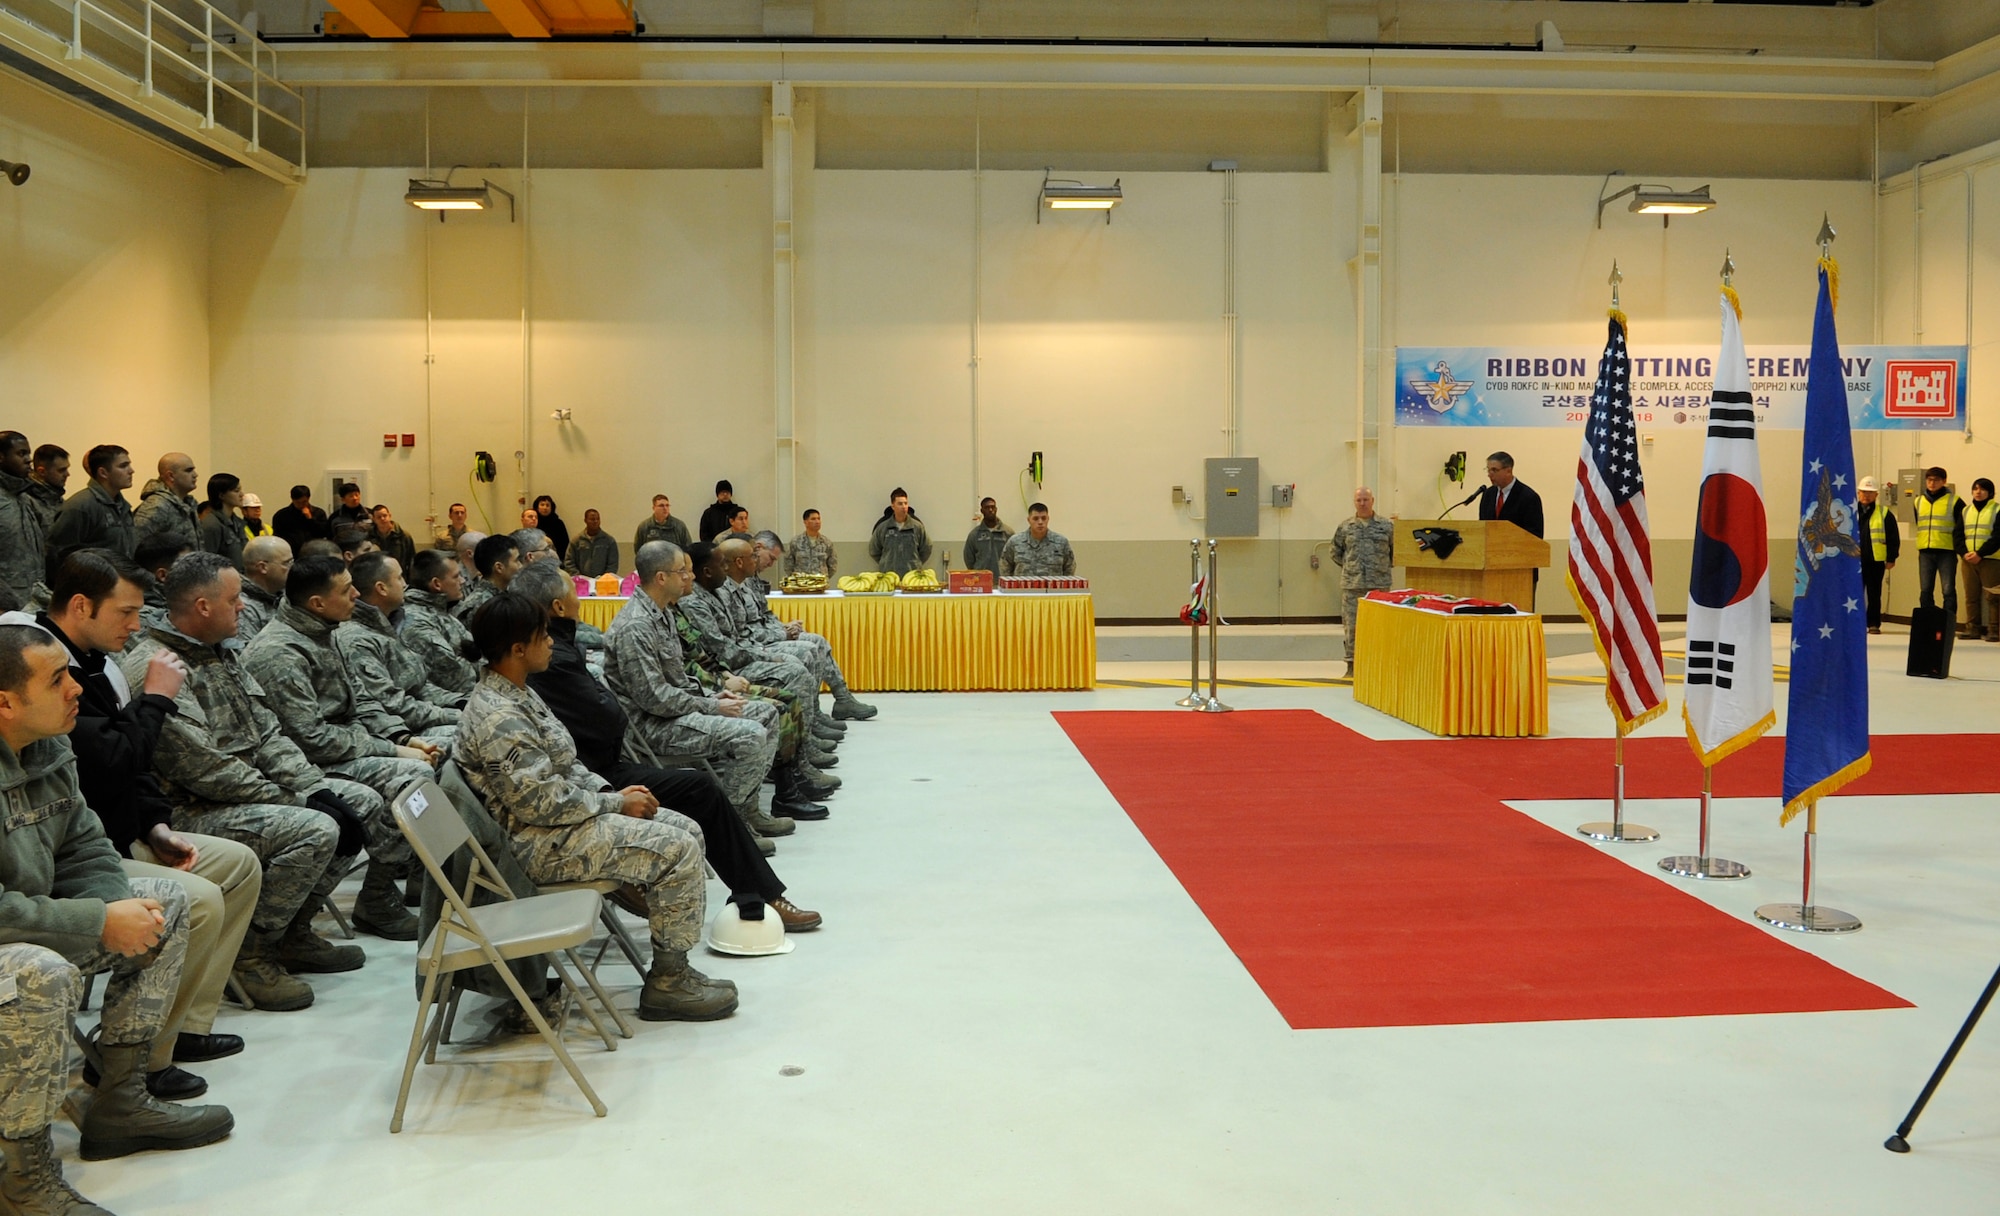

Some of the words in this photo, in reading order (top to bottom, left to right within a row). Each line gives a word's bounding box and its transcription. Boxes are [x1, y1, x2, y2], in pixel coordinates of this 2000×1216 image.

[1487, 358, 1586, 377] RIBBON
[1599, 358, 1711, 377] TTING
[1746, 357, 1872, 377] EREMNY
[1485, 381, 1508, 391] CY09
[1511, 381, 1539, 391] ROKFC
[1541, 381, 1575, 391] IN-KIND
[1685, 381, 1714, 391] ACCES
[1847, 382, 1872, 392] BASE
